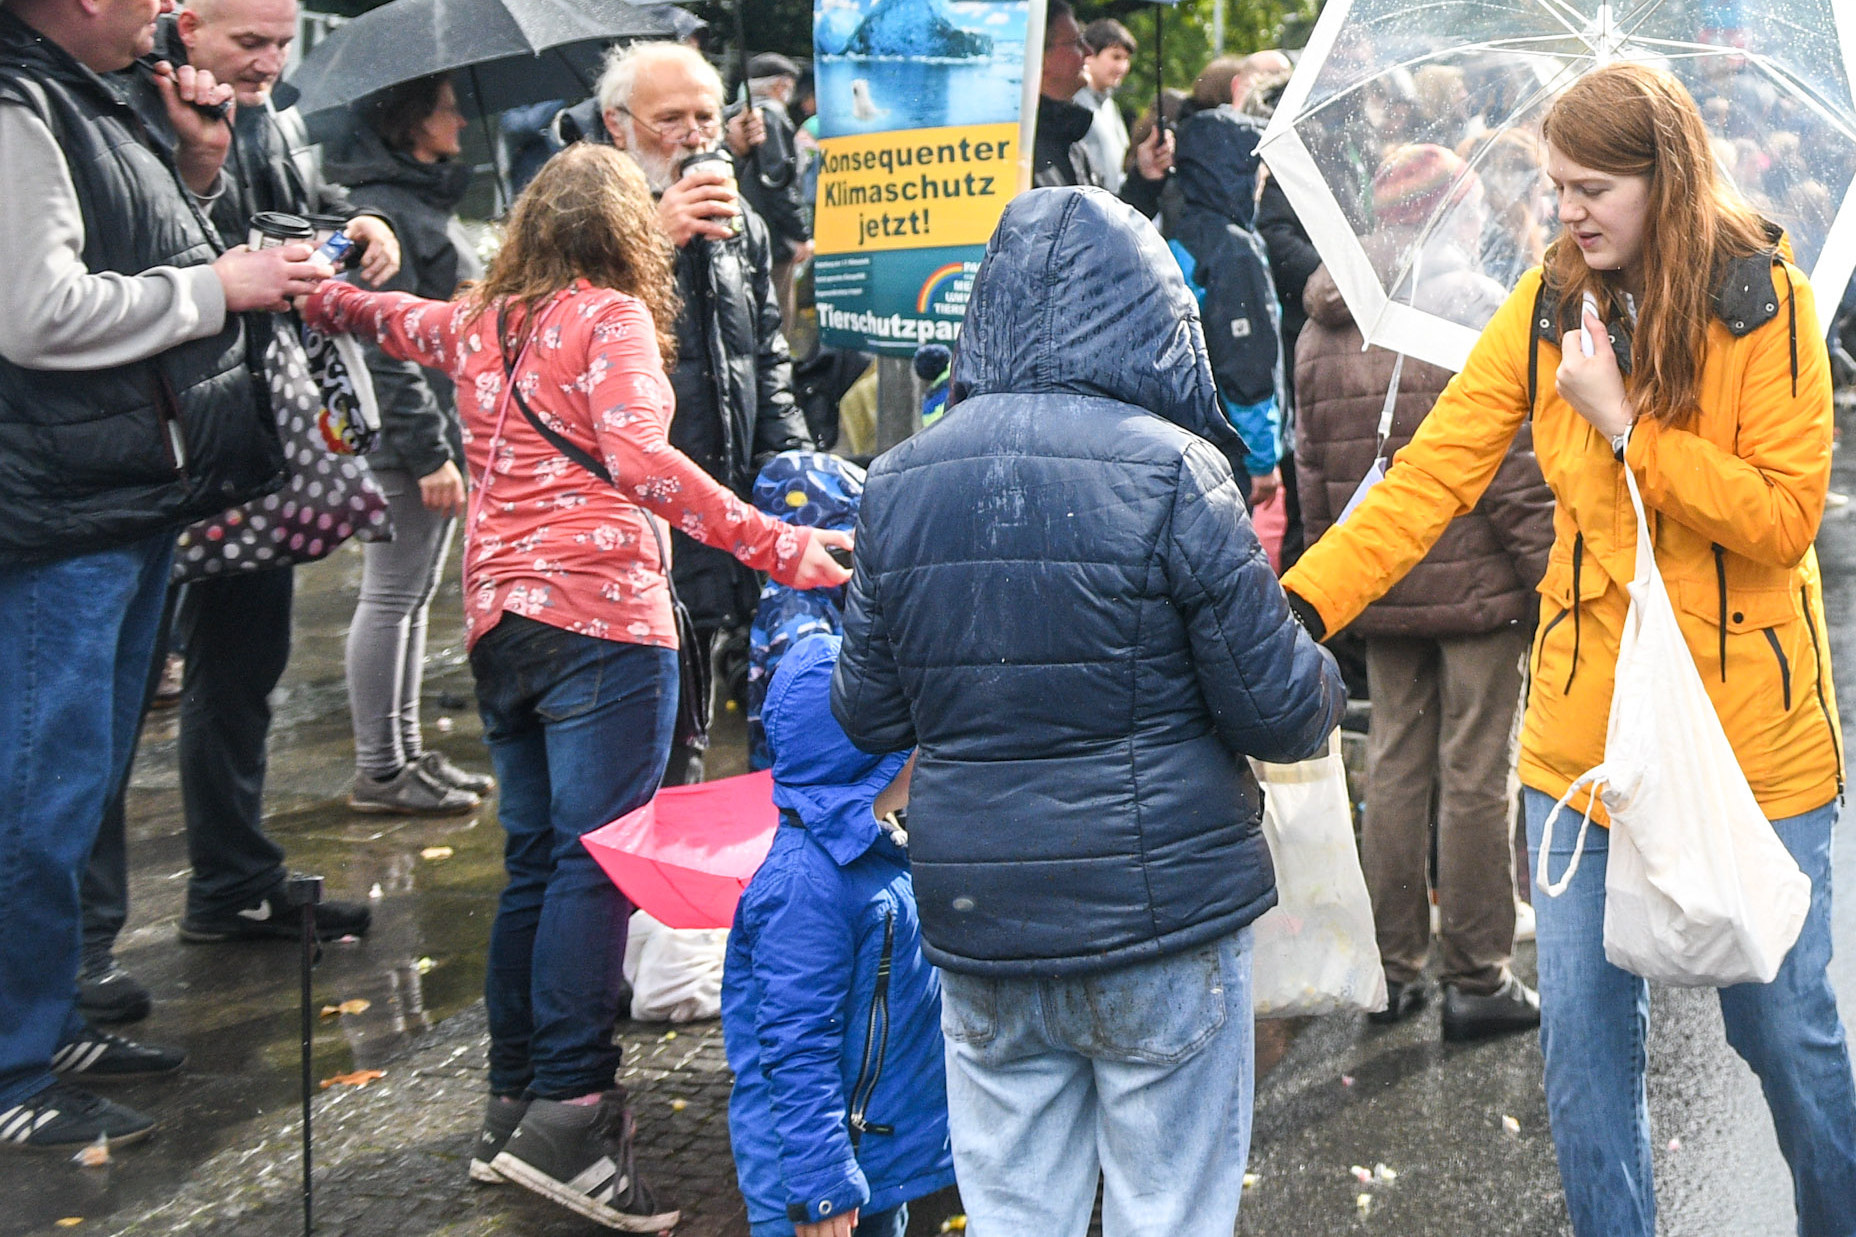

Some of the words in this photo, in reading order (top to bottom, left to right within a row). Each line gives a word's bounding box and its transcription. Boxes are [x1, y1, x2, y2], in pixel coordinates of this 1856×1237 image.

[818, 137, 1010, 174] Konsequenter
[825, 171, 995, 207] Klimaschutz
[858, 209, 930, 246] jetzt!
[815, 302, 962, 344] Tierschutzpar
